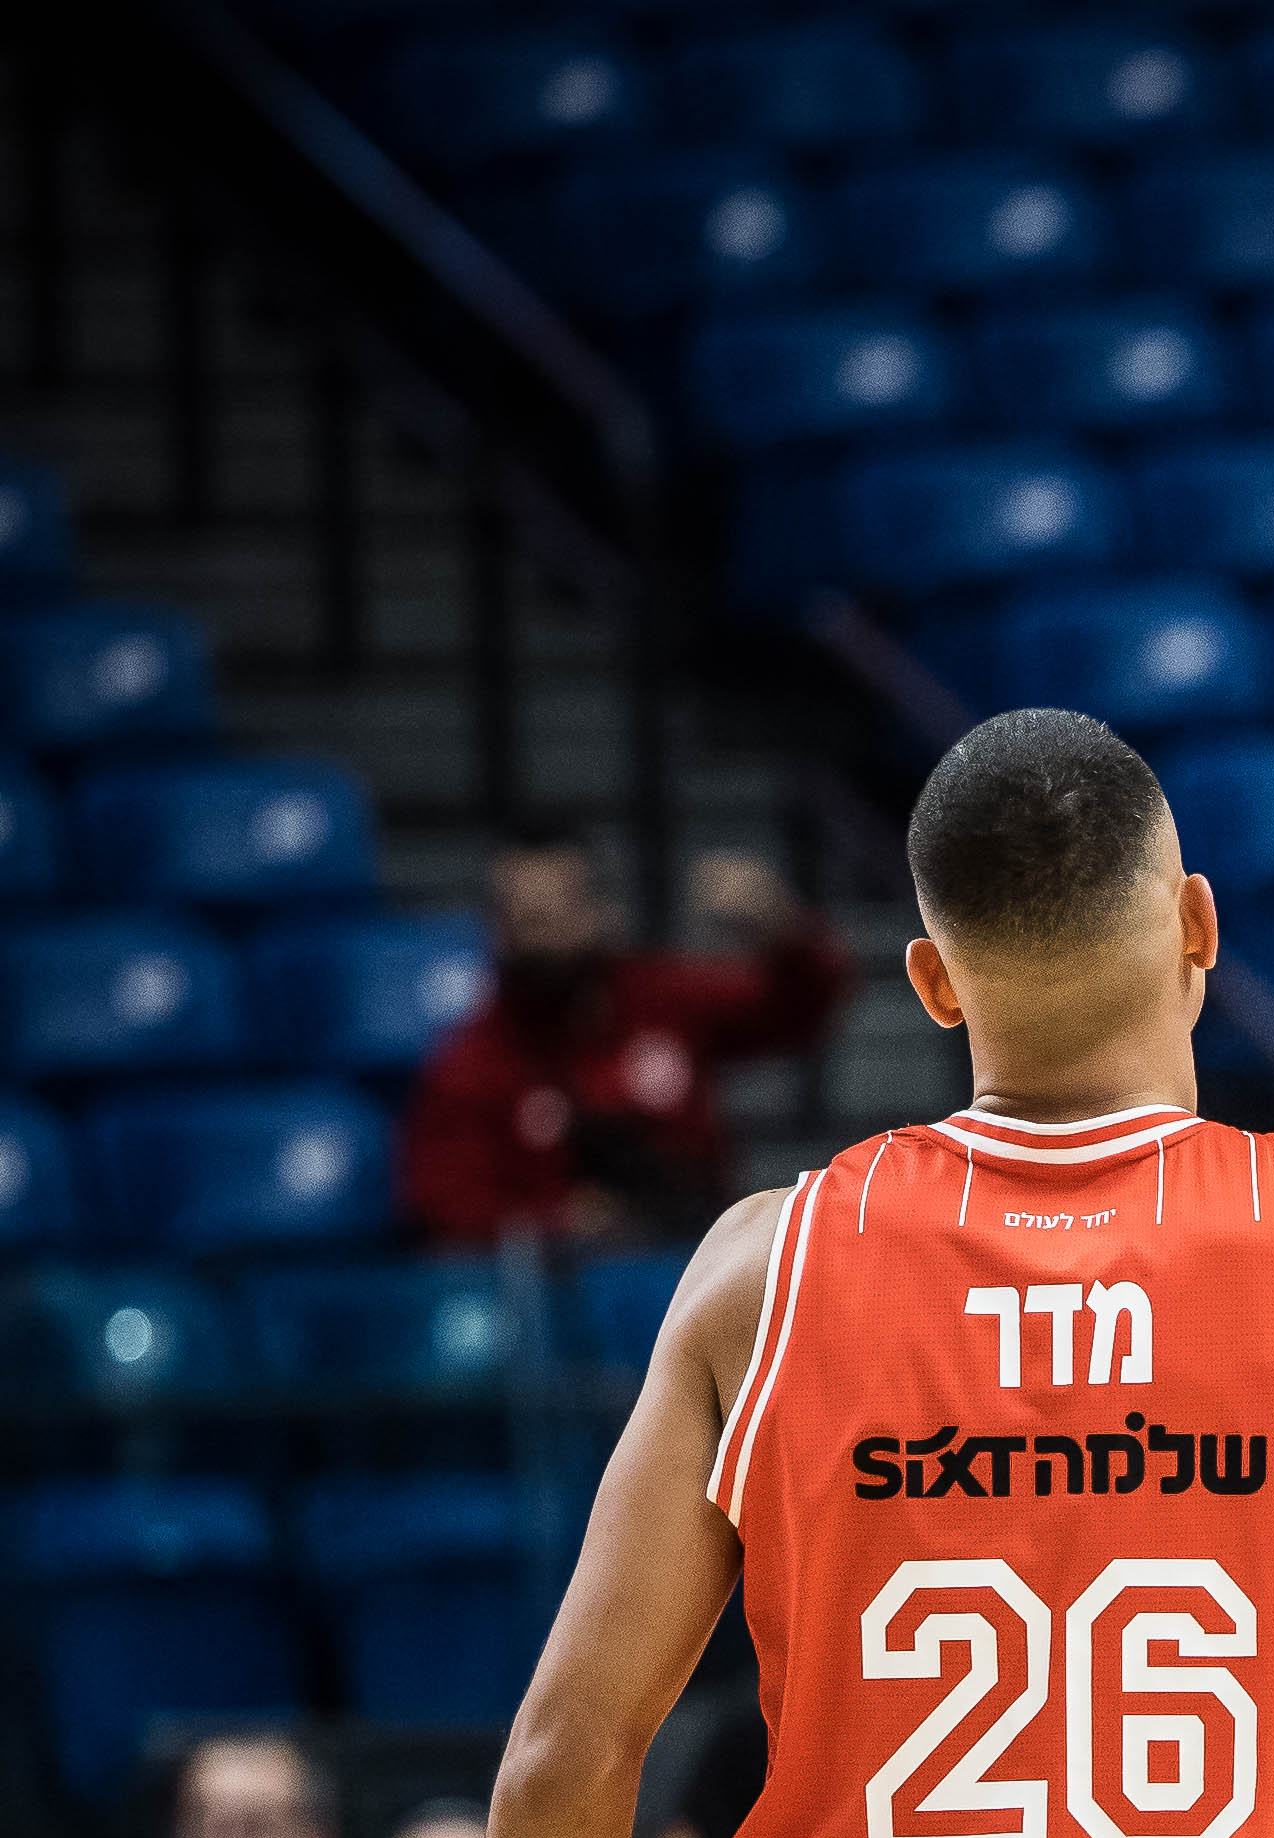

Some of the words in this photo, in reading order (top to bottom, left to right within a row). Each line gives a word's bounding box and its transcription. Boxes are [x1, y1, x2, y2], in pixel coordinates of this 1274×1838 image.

[1003, 1211, 1075, 1230] לעולם
[1080, 1208, 1117, 1229] יחד
[963, 1279, 1153, 1388] מדר
